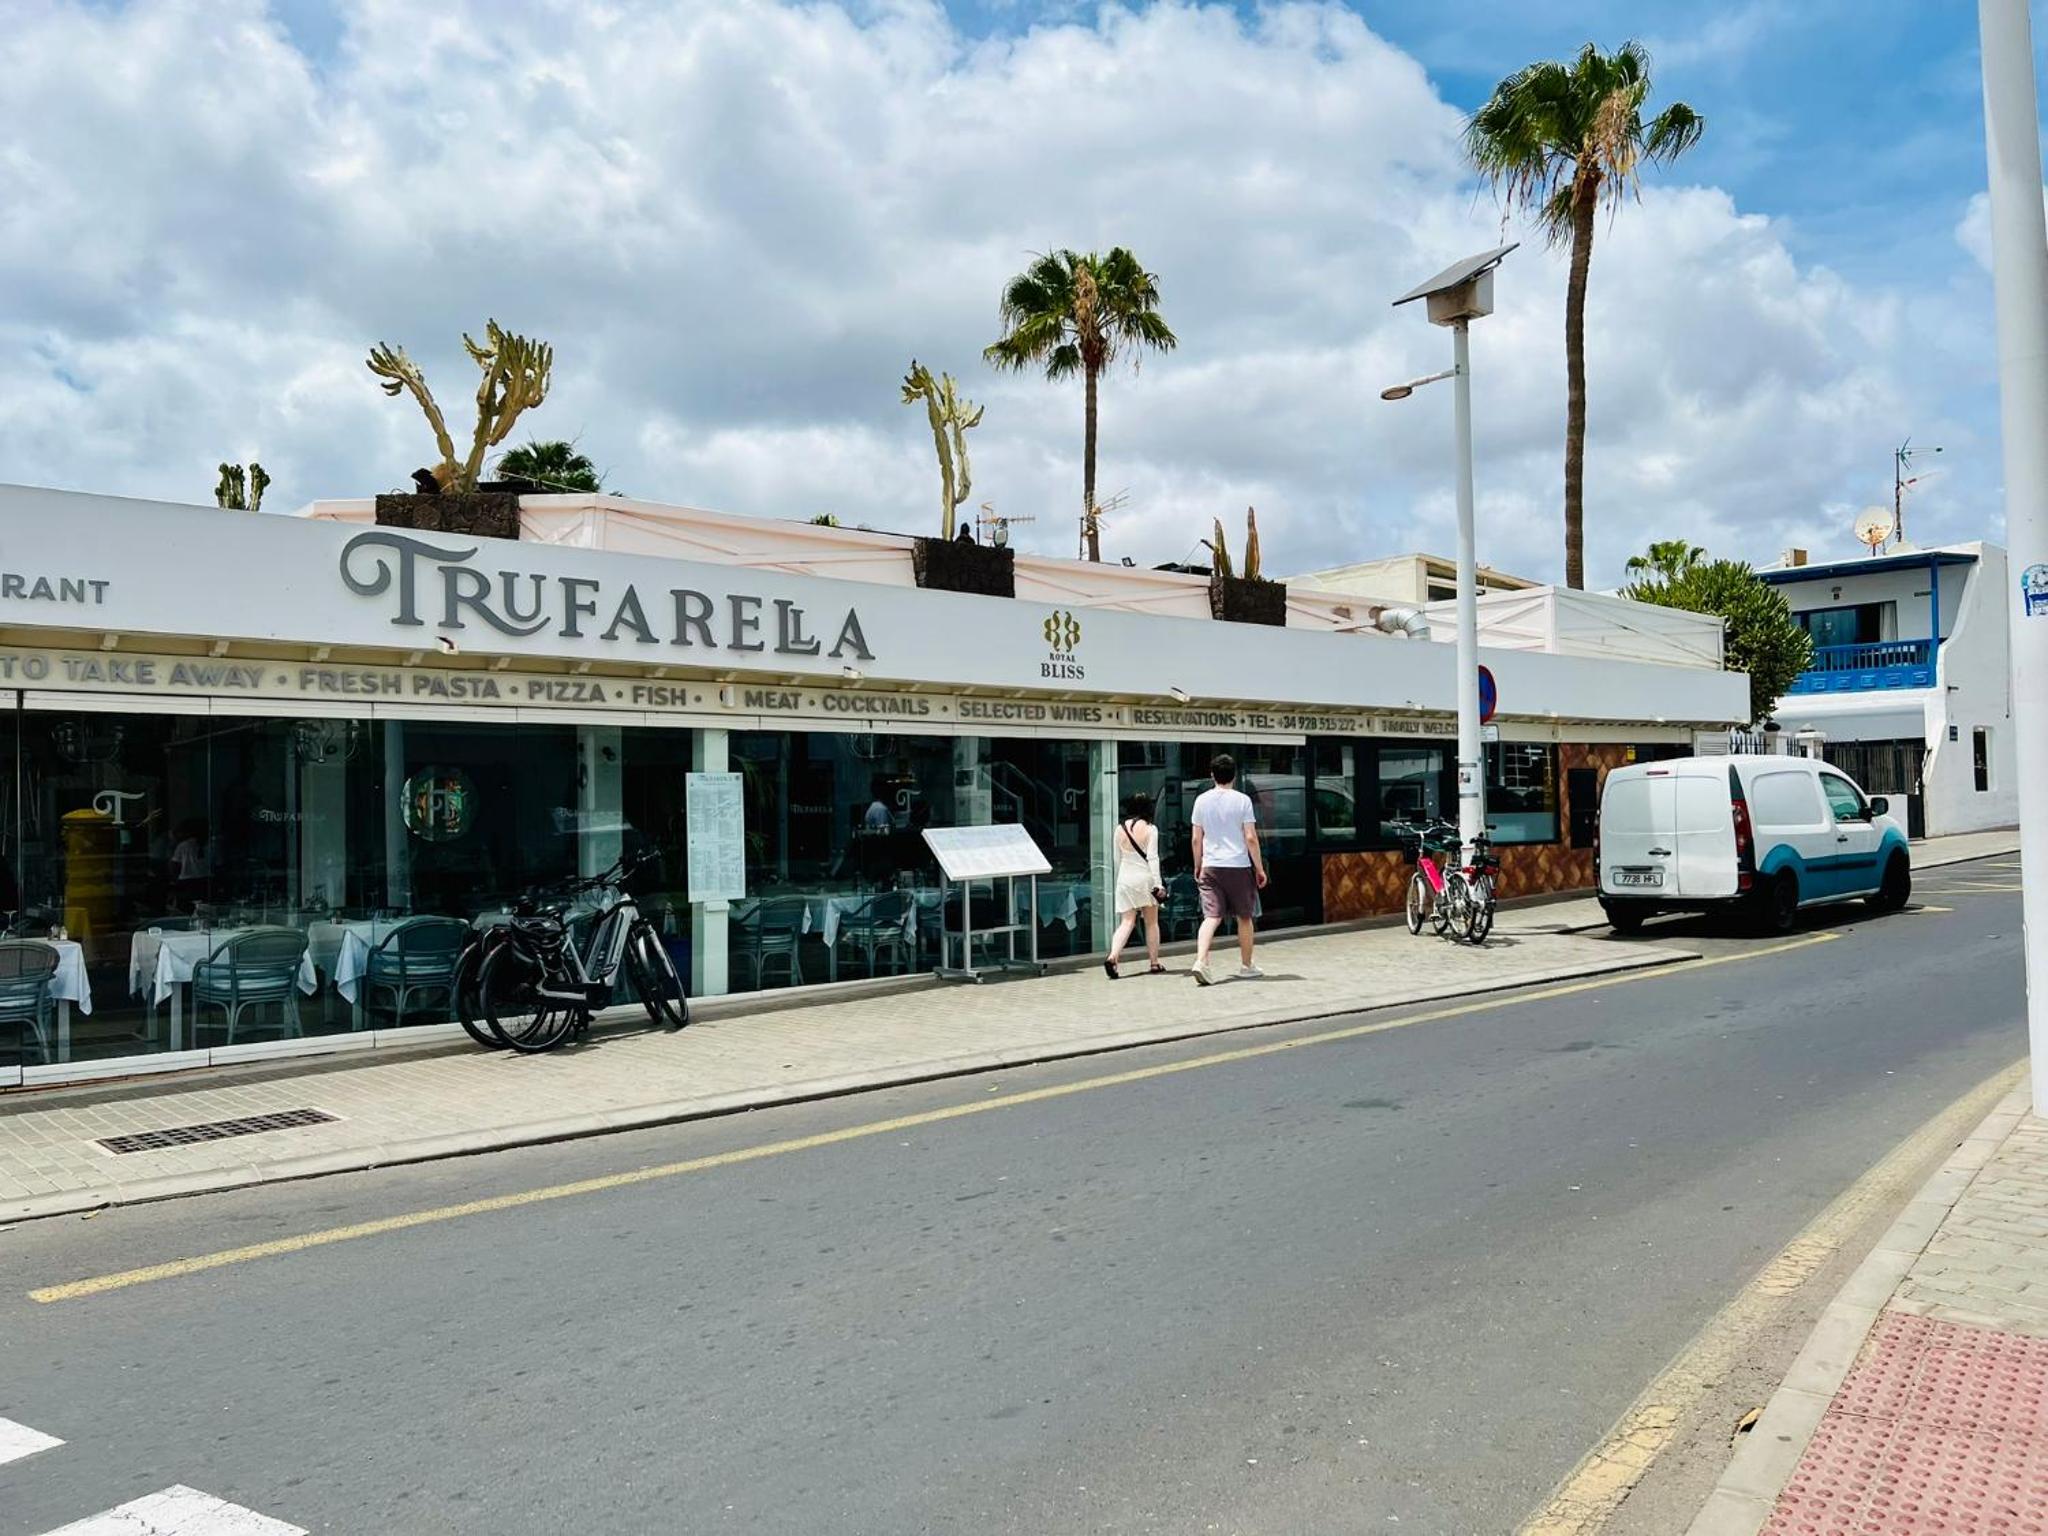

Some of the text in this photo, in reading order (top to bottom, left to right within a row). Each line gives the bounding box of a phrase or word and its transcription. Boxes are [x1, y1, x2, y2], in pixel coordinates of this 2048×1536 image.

[2, 573, 110, 604] RANT
[340, 531, 876, 661] TRUFARELLA
[1041, 663, 1085, 680] BLISS
[1050, 653, 1076, 663] ROYAL
[0, 655, 50, 681] TO
[61, 655, 157, 685] TAKE
[168, 662, 265, 689] AWAY
[299, 668, 402, 696] FRESH
[412, 675, 500, 698] PASTA
[528, 680, 607, 703] PIZZA
[632, 685, 687, 707] FISH
[744, 690, 802, 710] MEAT
[822, 694, 930, 716] COCKTAILS
[960, 698, 1046, 720] SELECTED
[1051, 704, 1102, 723] WINES
[1134, 709, 1237, 728] RESERVATIONS
